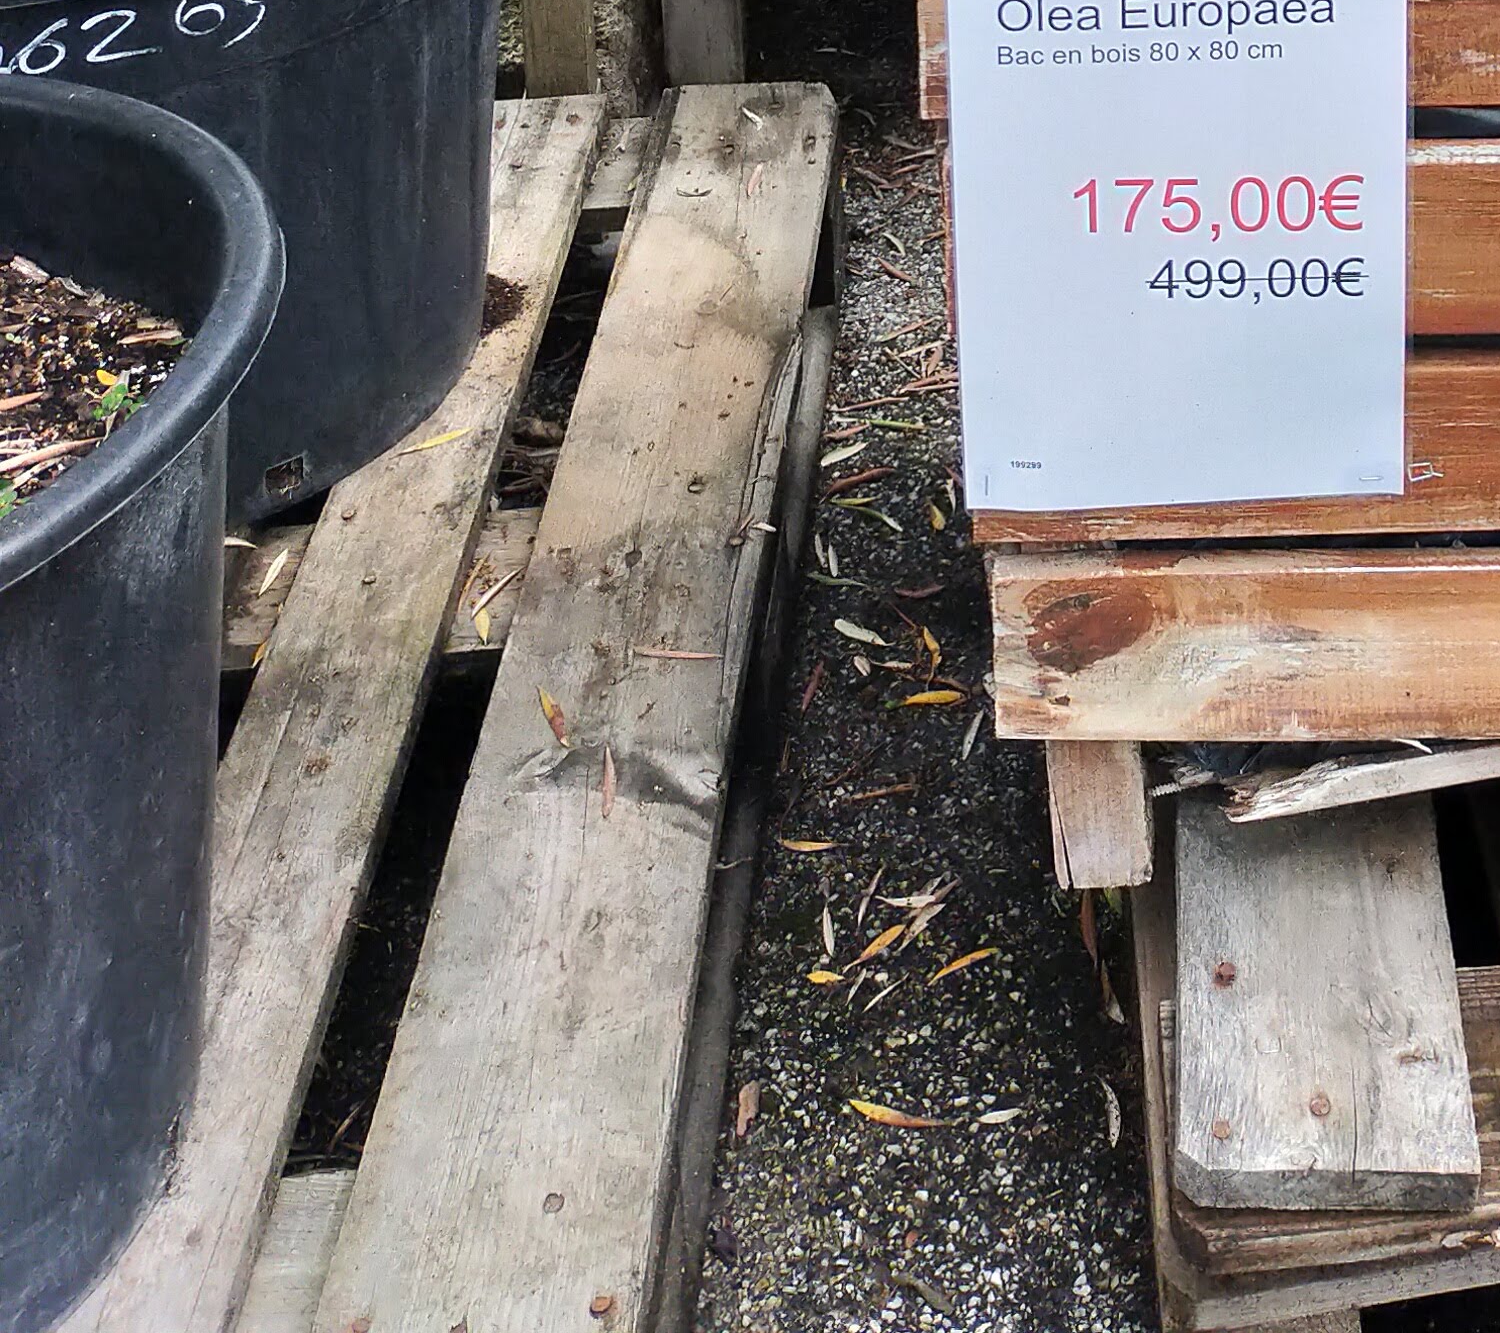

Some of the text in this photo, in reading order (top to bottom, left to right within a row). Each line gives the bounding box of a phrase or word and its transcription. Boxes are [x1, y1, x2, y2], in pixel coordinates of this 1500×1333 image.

[997, 39, 1283, 66] Bac en bois 80 x 80 cm
[1073, 174, 1365, 243] 175,00€
[1147, 257, 1367, 305] 499,00€
